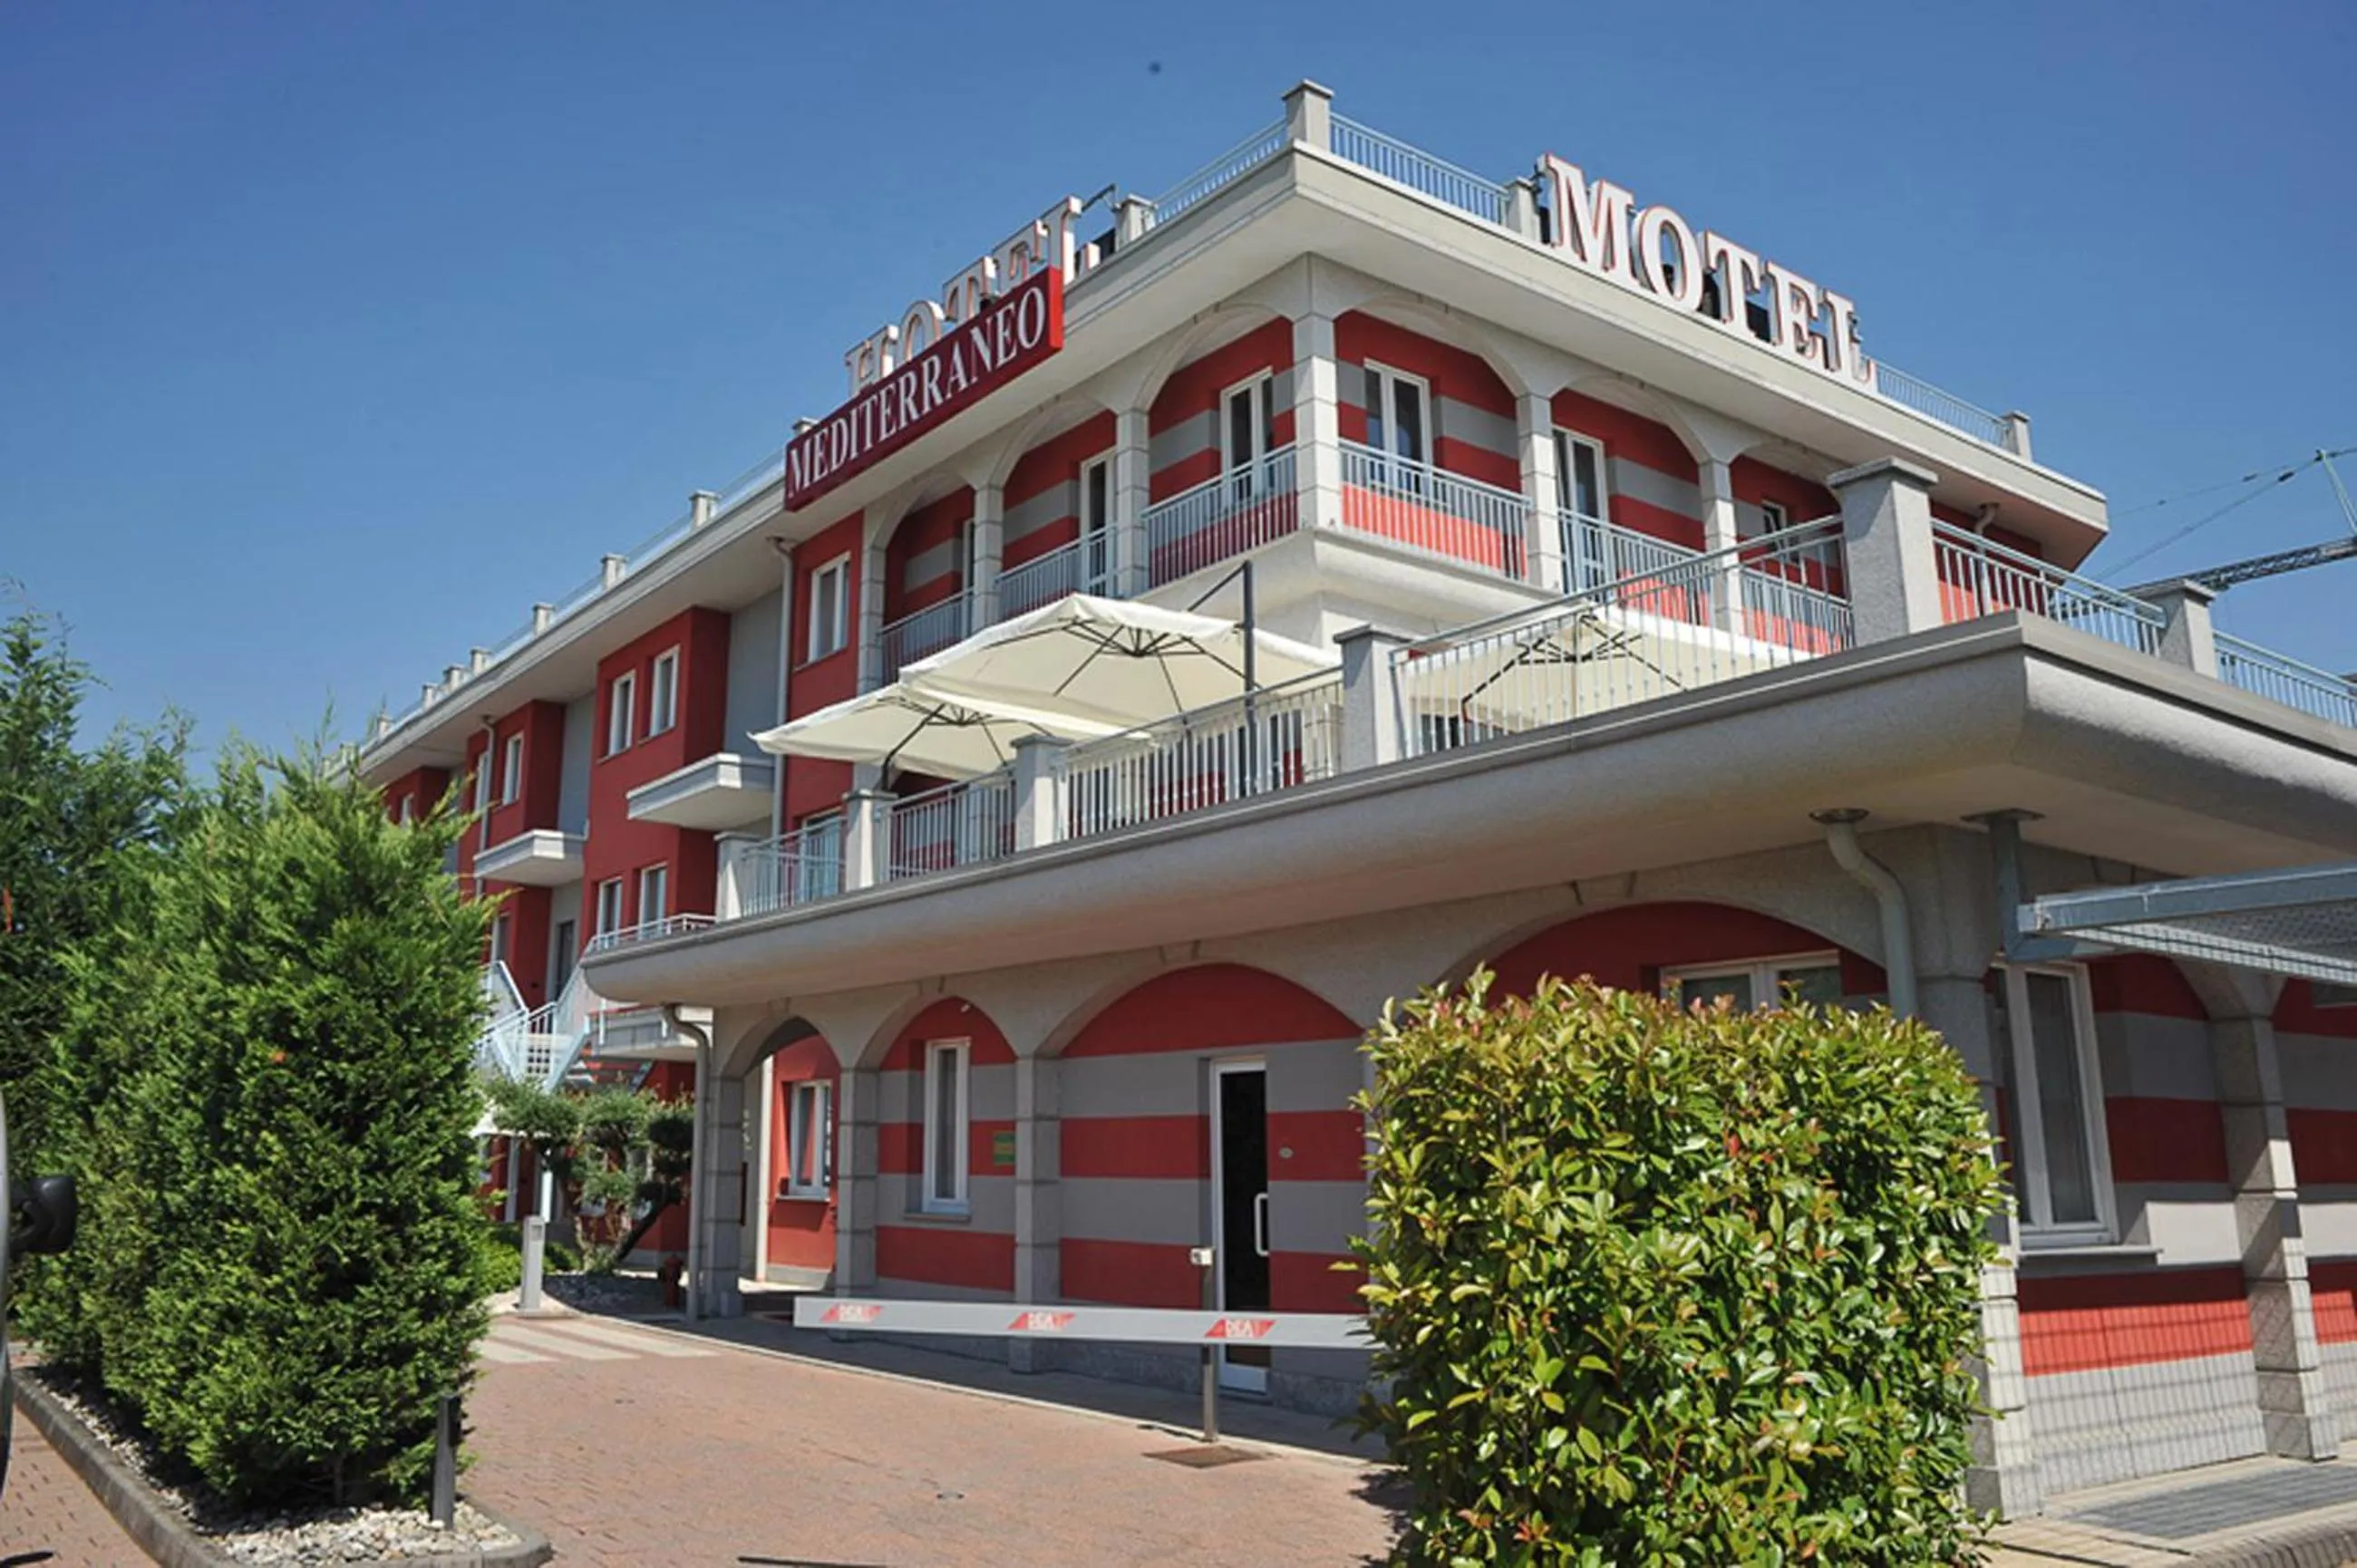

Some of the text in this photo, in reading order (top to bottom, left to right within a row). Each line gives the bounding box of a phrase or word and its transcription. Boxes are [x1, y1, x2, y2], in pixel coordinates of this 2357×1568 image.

[845, 195, 1101, 399] HOTEL
[1538, 152, 1878, 394] MOTEL
[788, 286, 1046, 498] MEDITERRANEO
